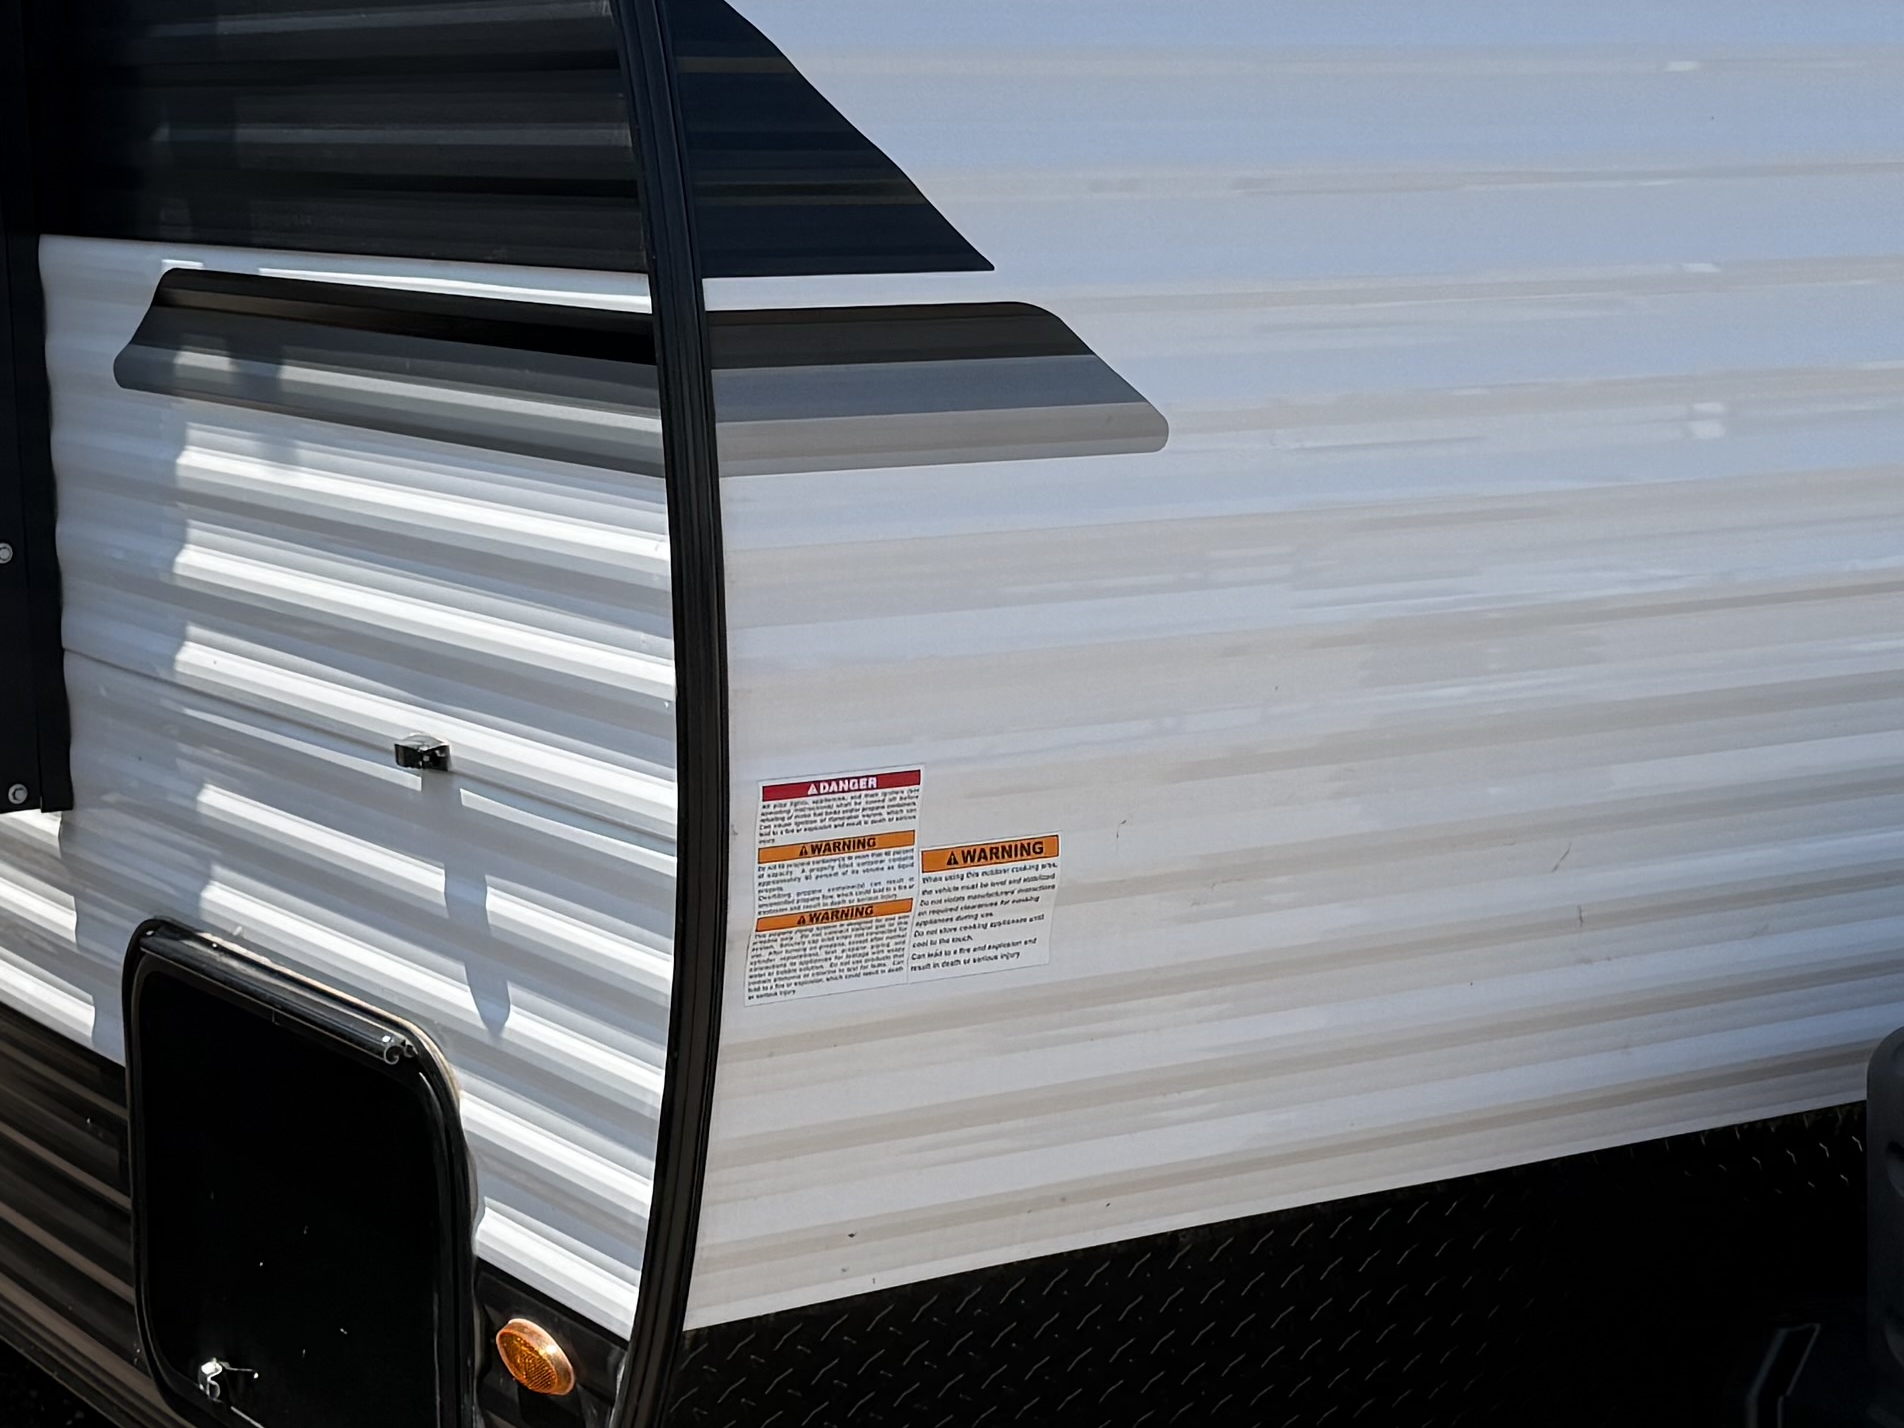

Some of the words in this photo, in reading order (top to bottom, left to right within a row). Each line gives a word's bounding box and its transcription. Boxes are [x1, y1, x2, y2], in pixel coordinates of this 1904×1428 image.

[819, 776, 877, 794] DANGER
[811, 837, 876, 855] WARNING
[960, 841, 1044, 864] WARNING
[808, 905, 873, 924] WARNING
